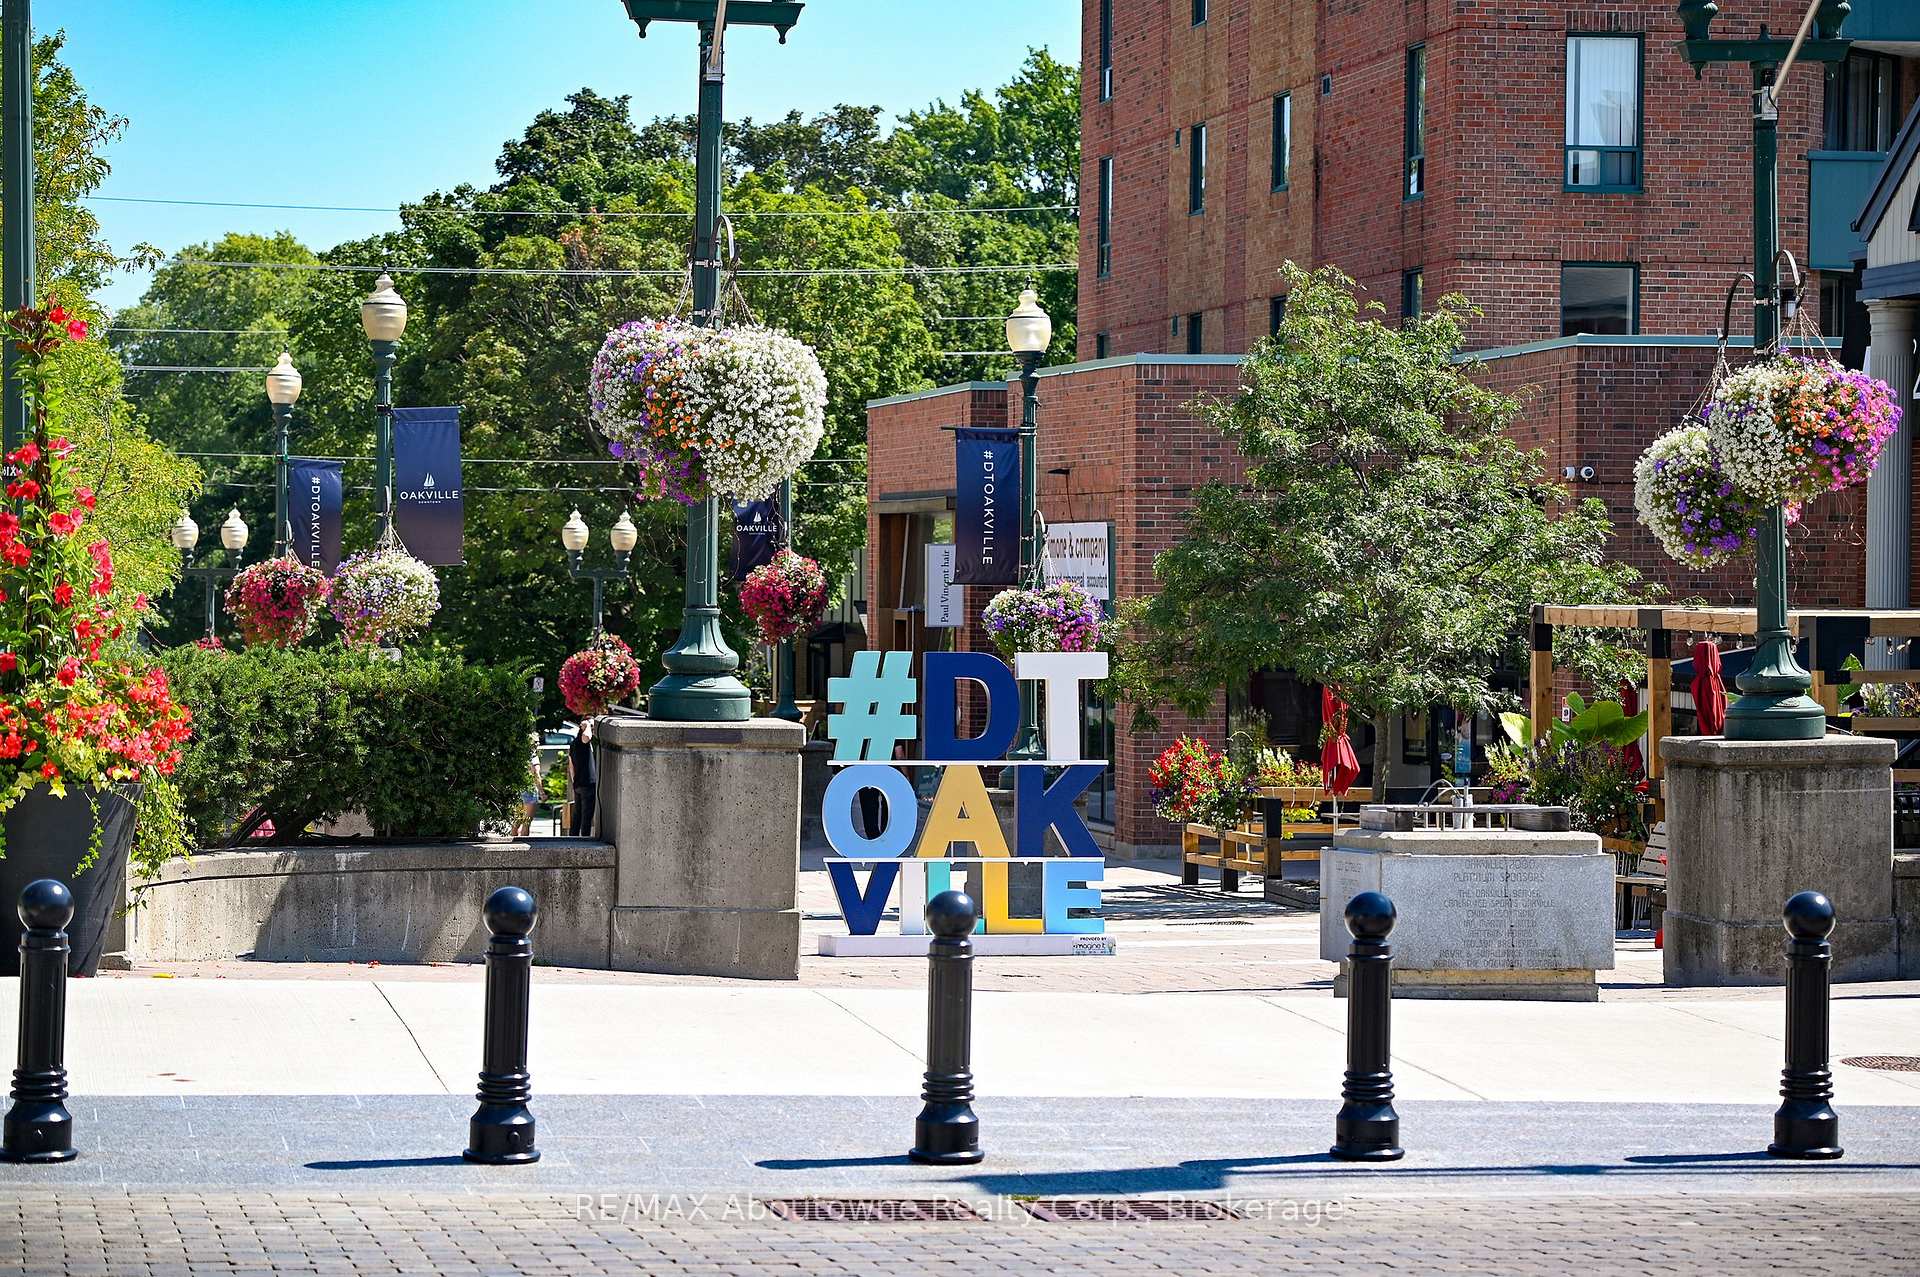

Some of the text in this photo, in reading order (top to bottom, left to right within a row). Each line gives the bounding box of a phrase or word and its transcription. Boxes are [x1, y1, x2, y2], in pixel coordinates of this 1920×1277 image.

[311, 476, 321, 569] #DTOAKVILLE
[400, 490, 459, 500] OAKVILLE
[736, 524, 778, 532] OAKVILLE
[982, 449, 995, 566] #DTOAKVILLE
[940, 550, 950, 623] Paul Vincent hair
[1075, 537, 1107, 566] company
[827, 651, 1109, 761] #DT
[822, 763, 1109, 858] OAK
